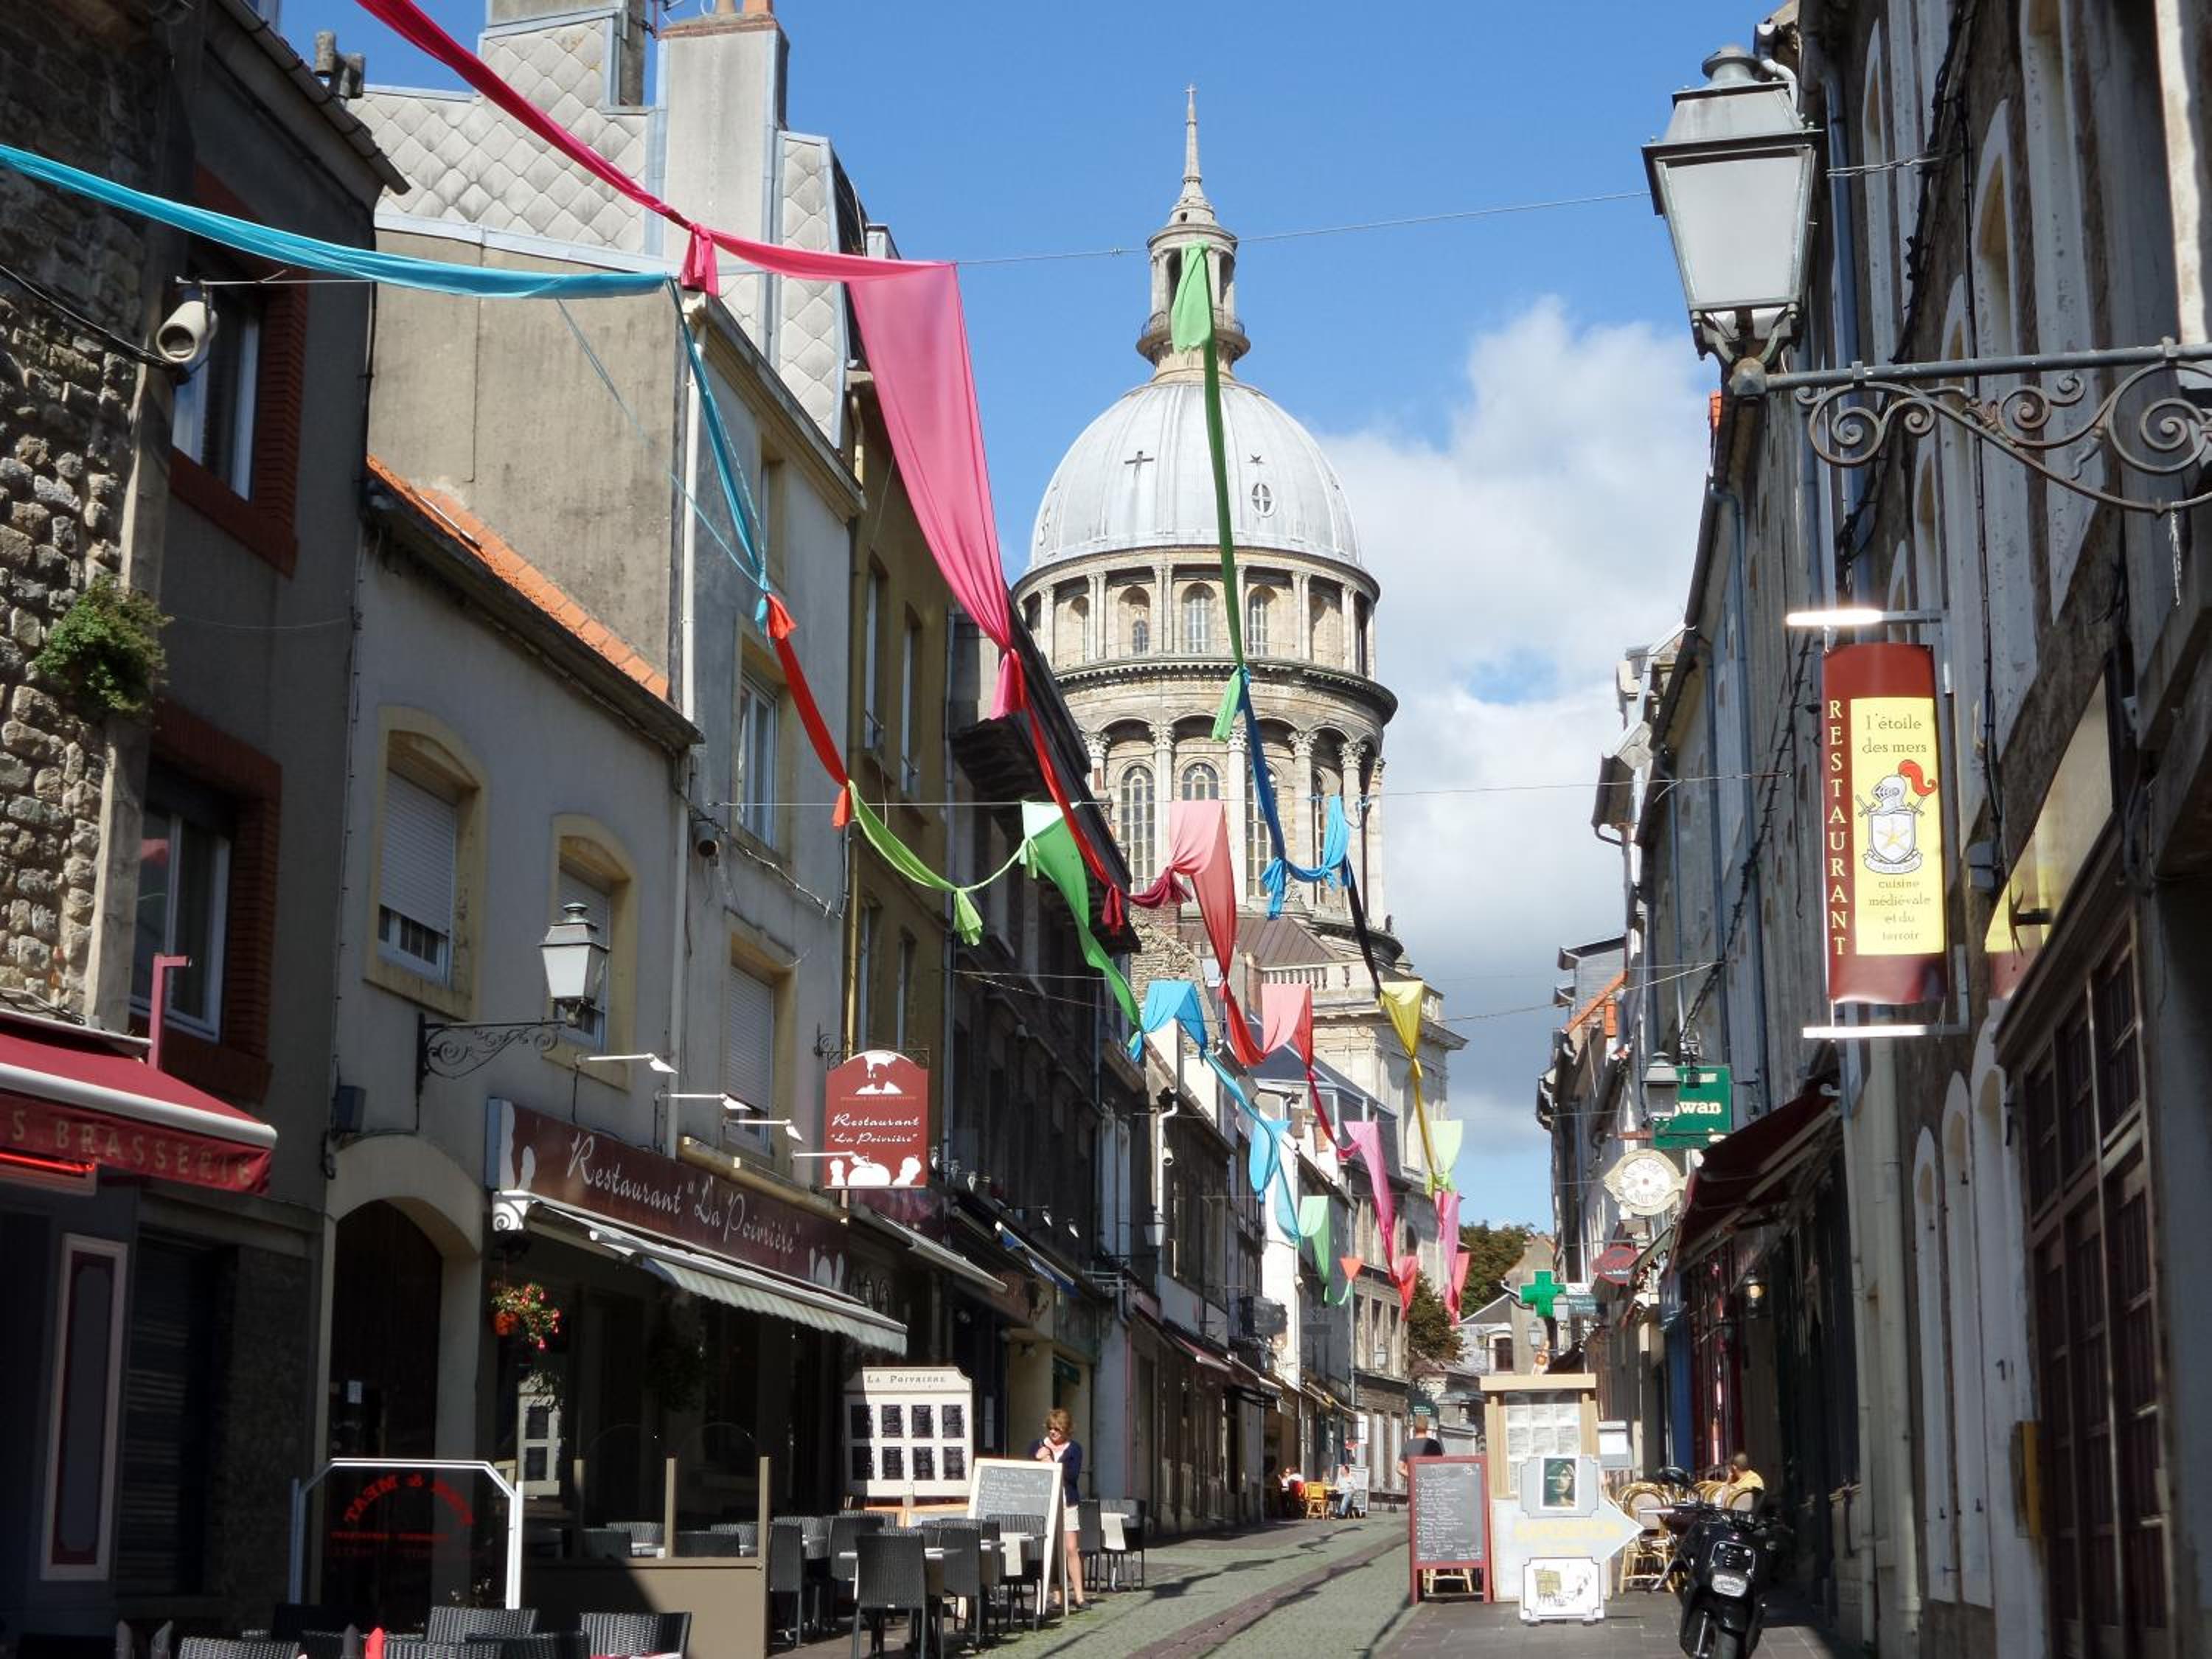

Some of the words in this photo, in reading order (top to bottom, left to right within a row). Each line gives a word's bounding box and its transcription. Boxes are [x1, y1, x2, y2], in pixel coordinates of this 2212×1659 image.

[1866, 712, 1922, 730] l'étoile
[1862, 737, 1888, 754] des
[1893, 743, 1927, 754] mers
[1828, 700, 1848, 956] RESTAURANT
[1878, 878, 1920, 888] cuisine
[1884, 912, 1897, 924] et
[1899, 911, 1916, 922] du
[832, 1113, 919, 1127] Restaurant
[55, 1120, 252, 1186] BRASSERIE
[567, 1132, 681, 1214] Restaurant
